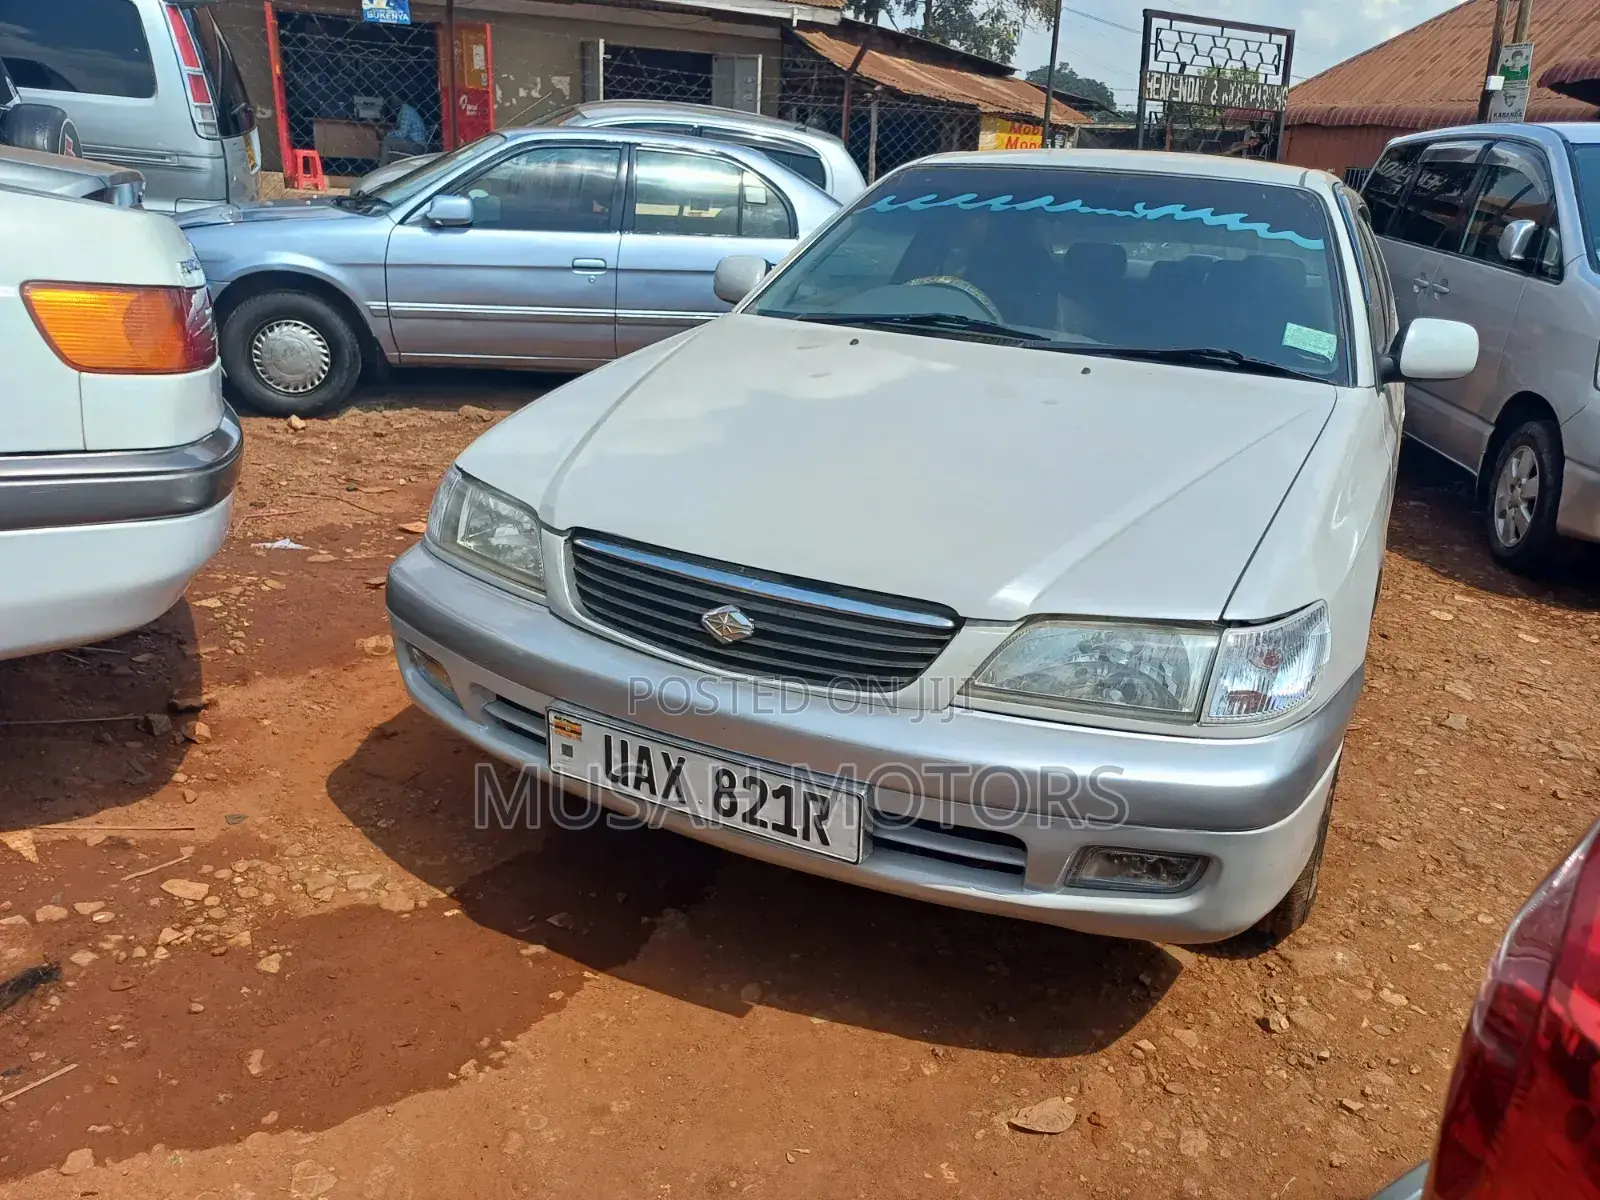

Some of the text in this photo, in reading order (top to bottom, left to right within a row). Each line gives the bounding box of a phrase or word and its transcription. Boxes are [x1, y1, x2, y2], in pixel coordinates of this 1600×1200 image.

[366, 10, 409, 20] BUKENYA
[1009, 123, 1041, 135] Mob
[604, 733, 831, 847] UAX 821R
